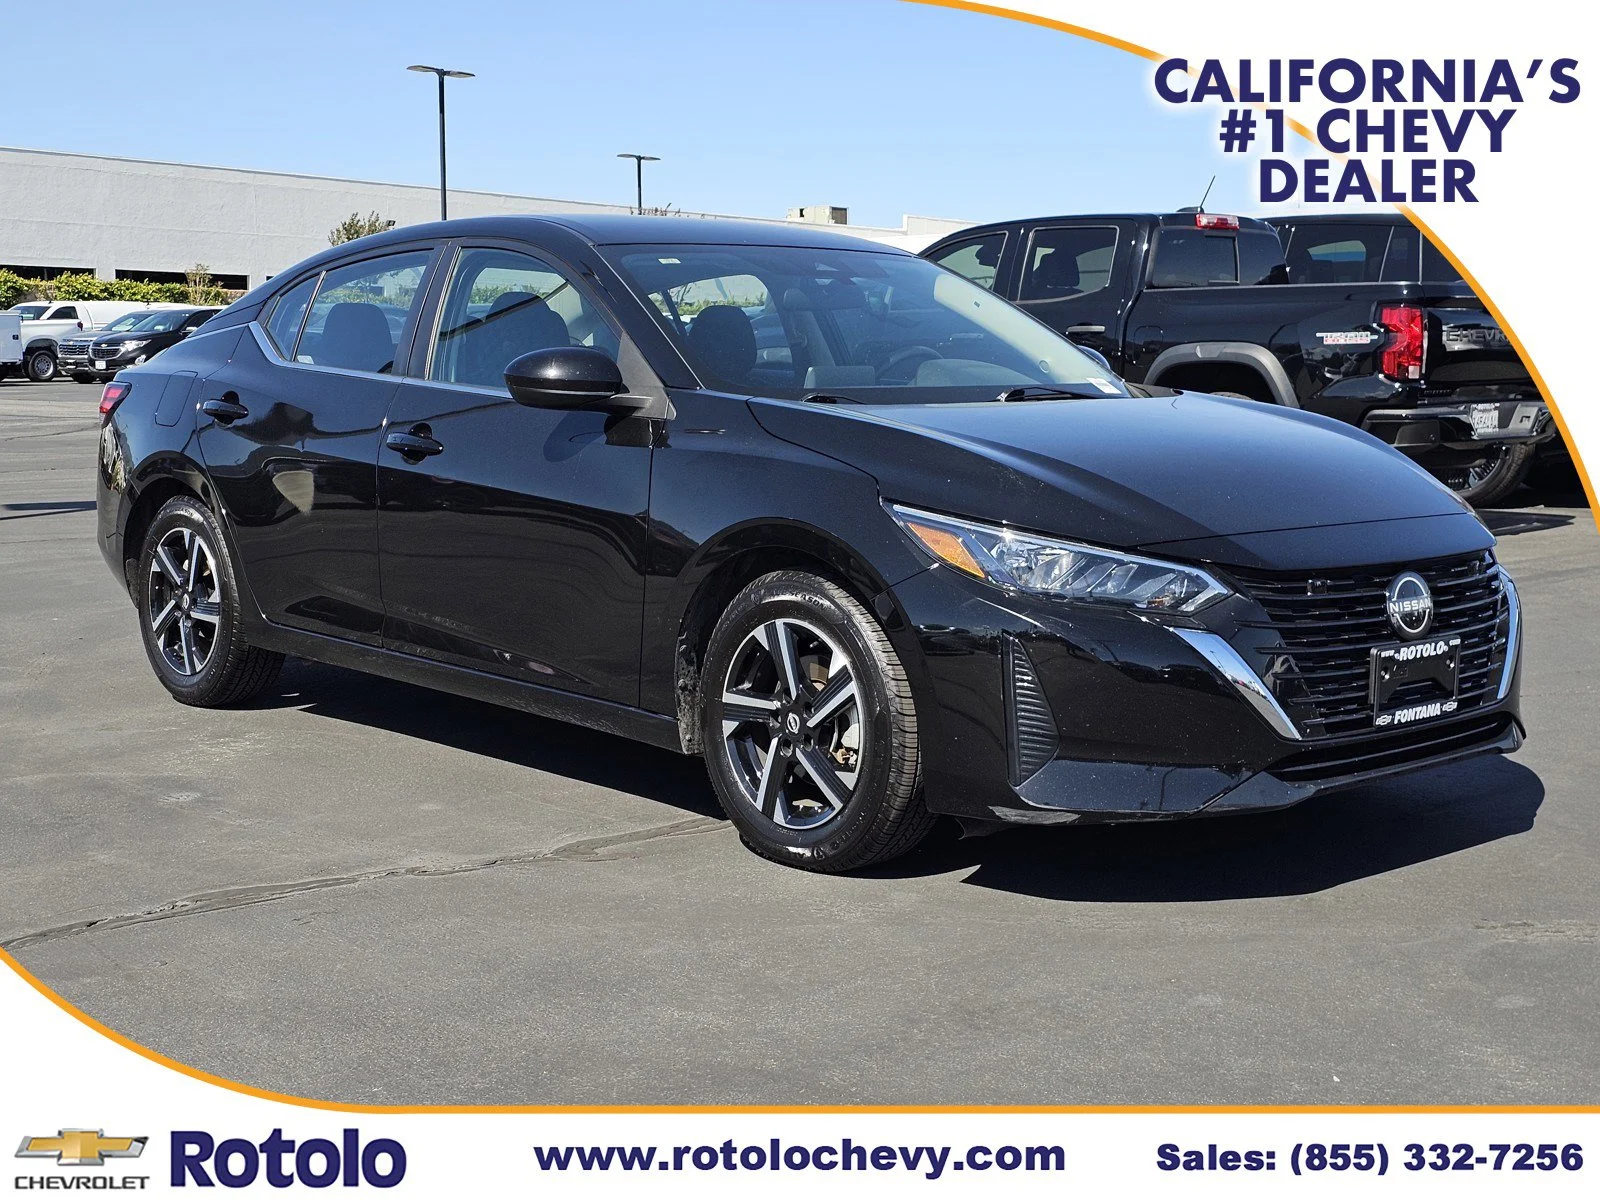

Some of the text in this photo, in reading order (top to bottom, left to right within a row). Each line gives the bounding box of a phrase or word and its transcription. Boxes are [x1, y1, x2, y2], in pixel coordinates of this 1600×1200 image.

[1446, 327, 1508, 342] CHEVR
[1389, 597, 1431, 613] NISSAN
[1399, 640, 1445, 662] ROTOLO
[1393, 702, 1441, 725] FONTANA
